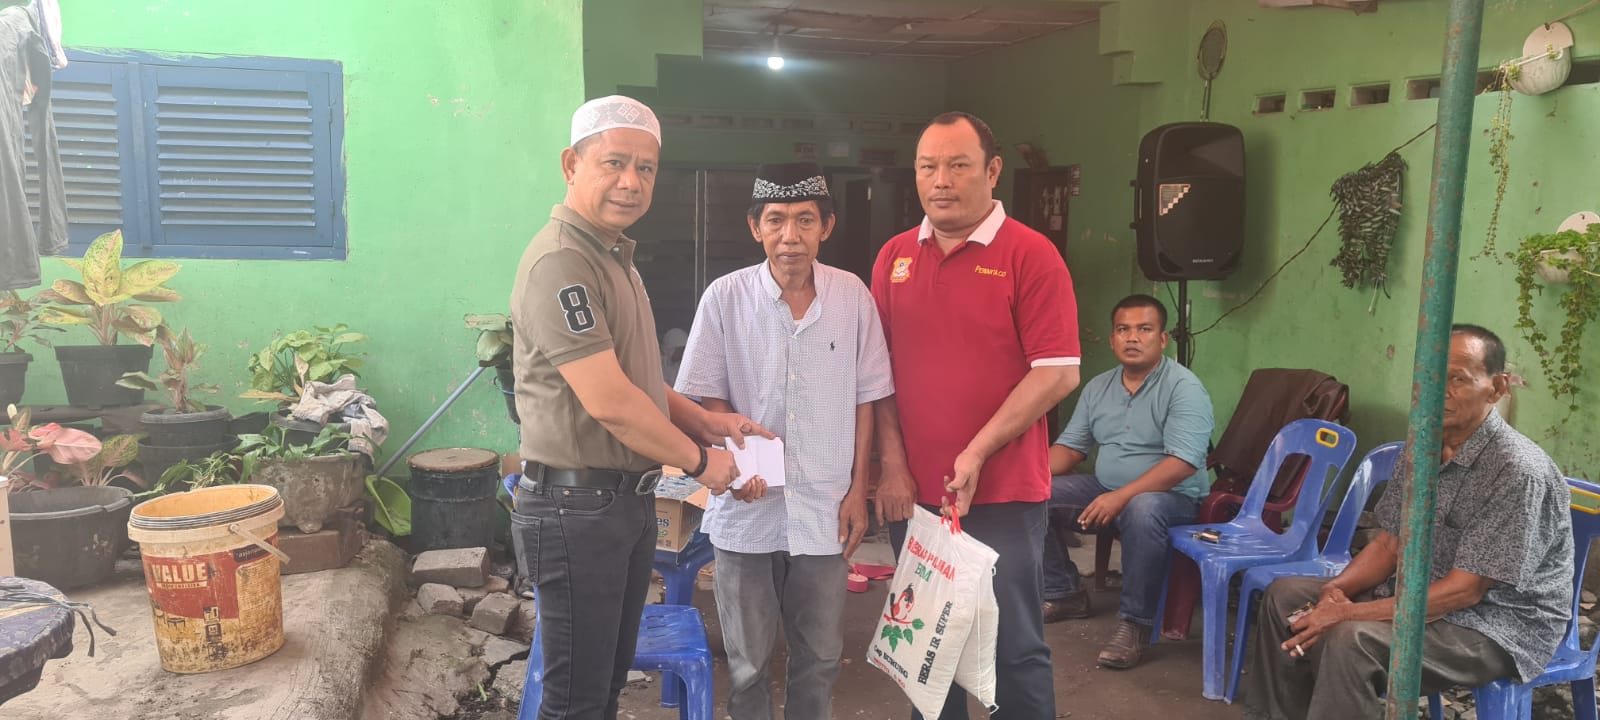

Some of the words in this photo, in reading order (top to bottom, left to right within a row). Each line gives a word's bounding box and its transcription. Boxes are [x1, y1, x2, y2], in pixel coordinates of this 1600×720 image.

[557, 283, 596, 333] 8
[151, 562, 208, 583] VALUE
[935, 600, 954, 636] SUPER
[930, 636, 942, 650] IR
[917, 650, 936, 685] BERAS
